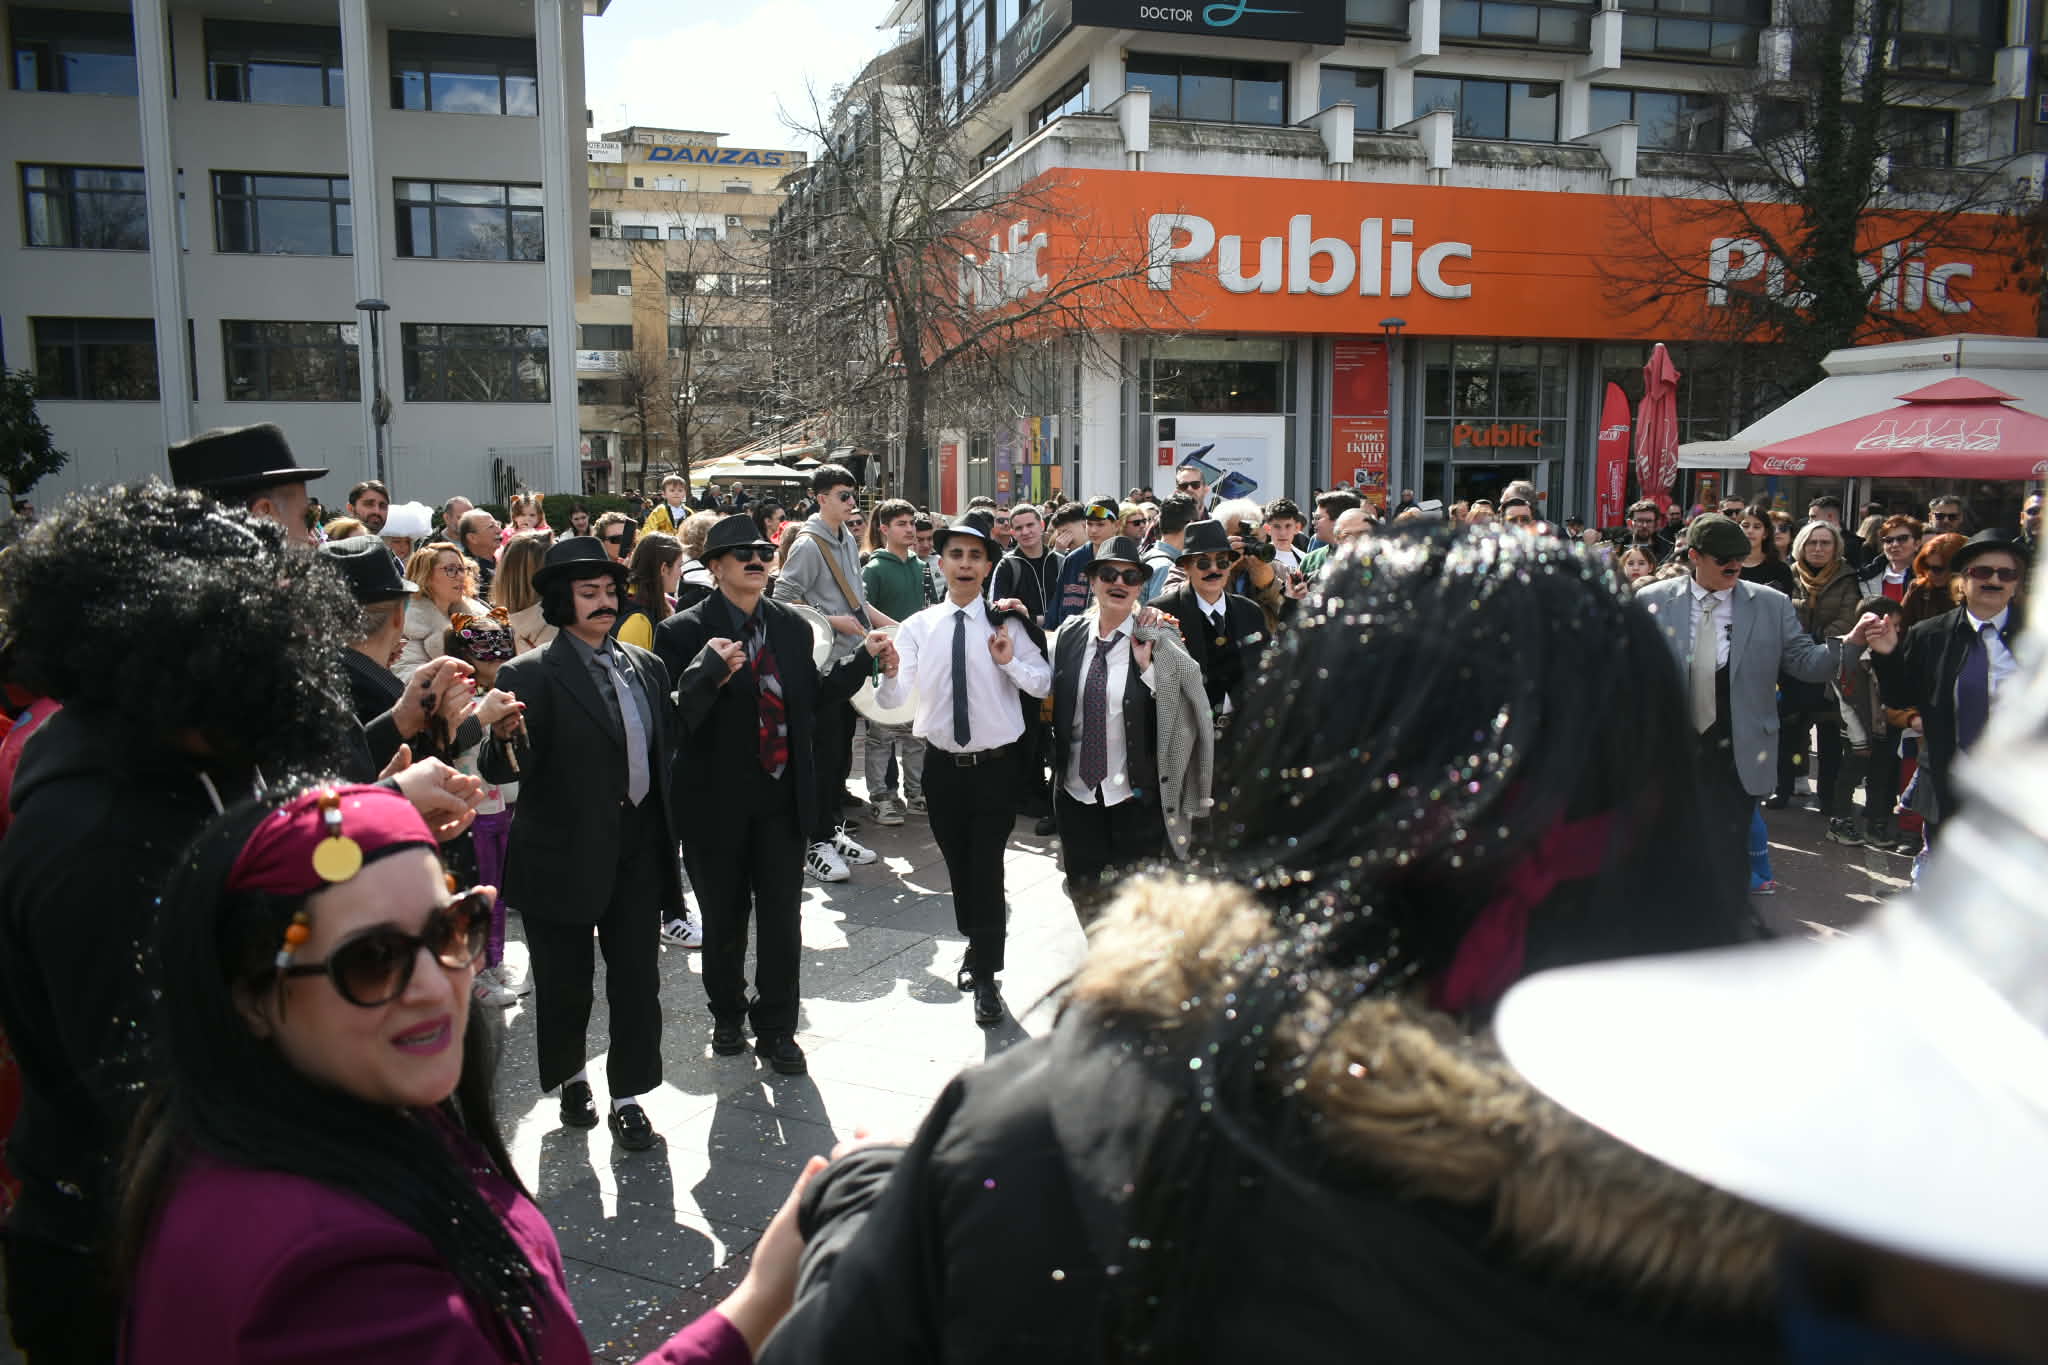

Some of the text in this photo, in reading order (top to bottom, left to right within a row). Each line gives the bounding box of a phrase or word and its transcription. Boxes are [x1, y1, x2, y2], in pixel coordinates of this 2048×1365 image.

[1137, 6, 1193, 22] DOCTOR
[648, 147, 785, 166] DANZAS
[1147, 212, 1472, 299] Public
[1453, 423, 1544, 448] Public
[1763, 456, 1809, 471] Coca-Cola
[807, 852, 833, 876] AIR
